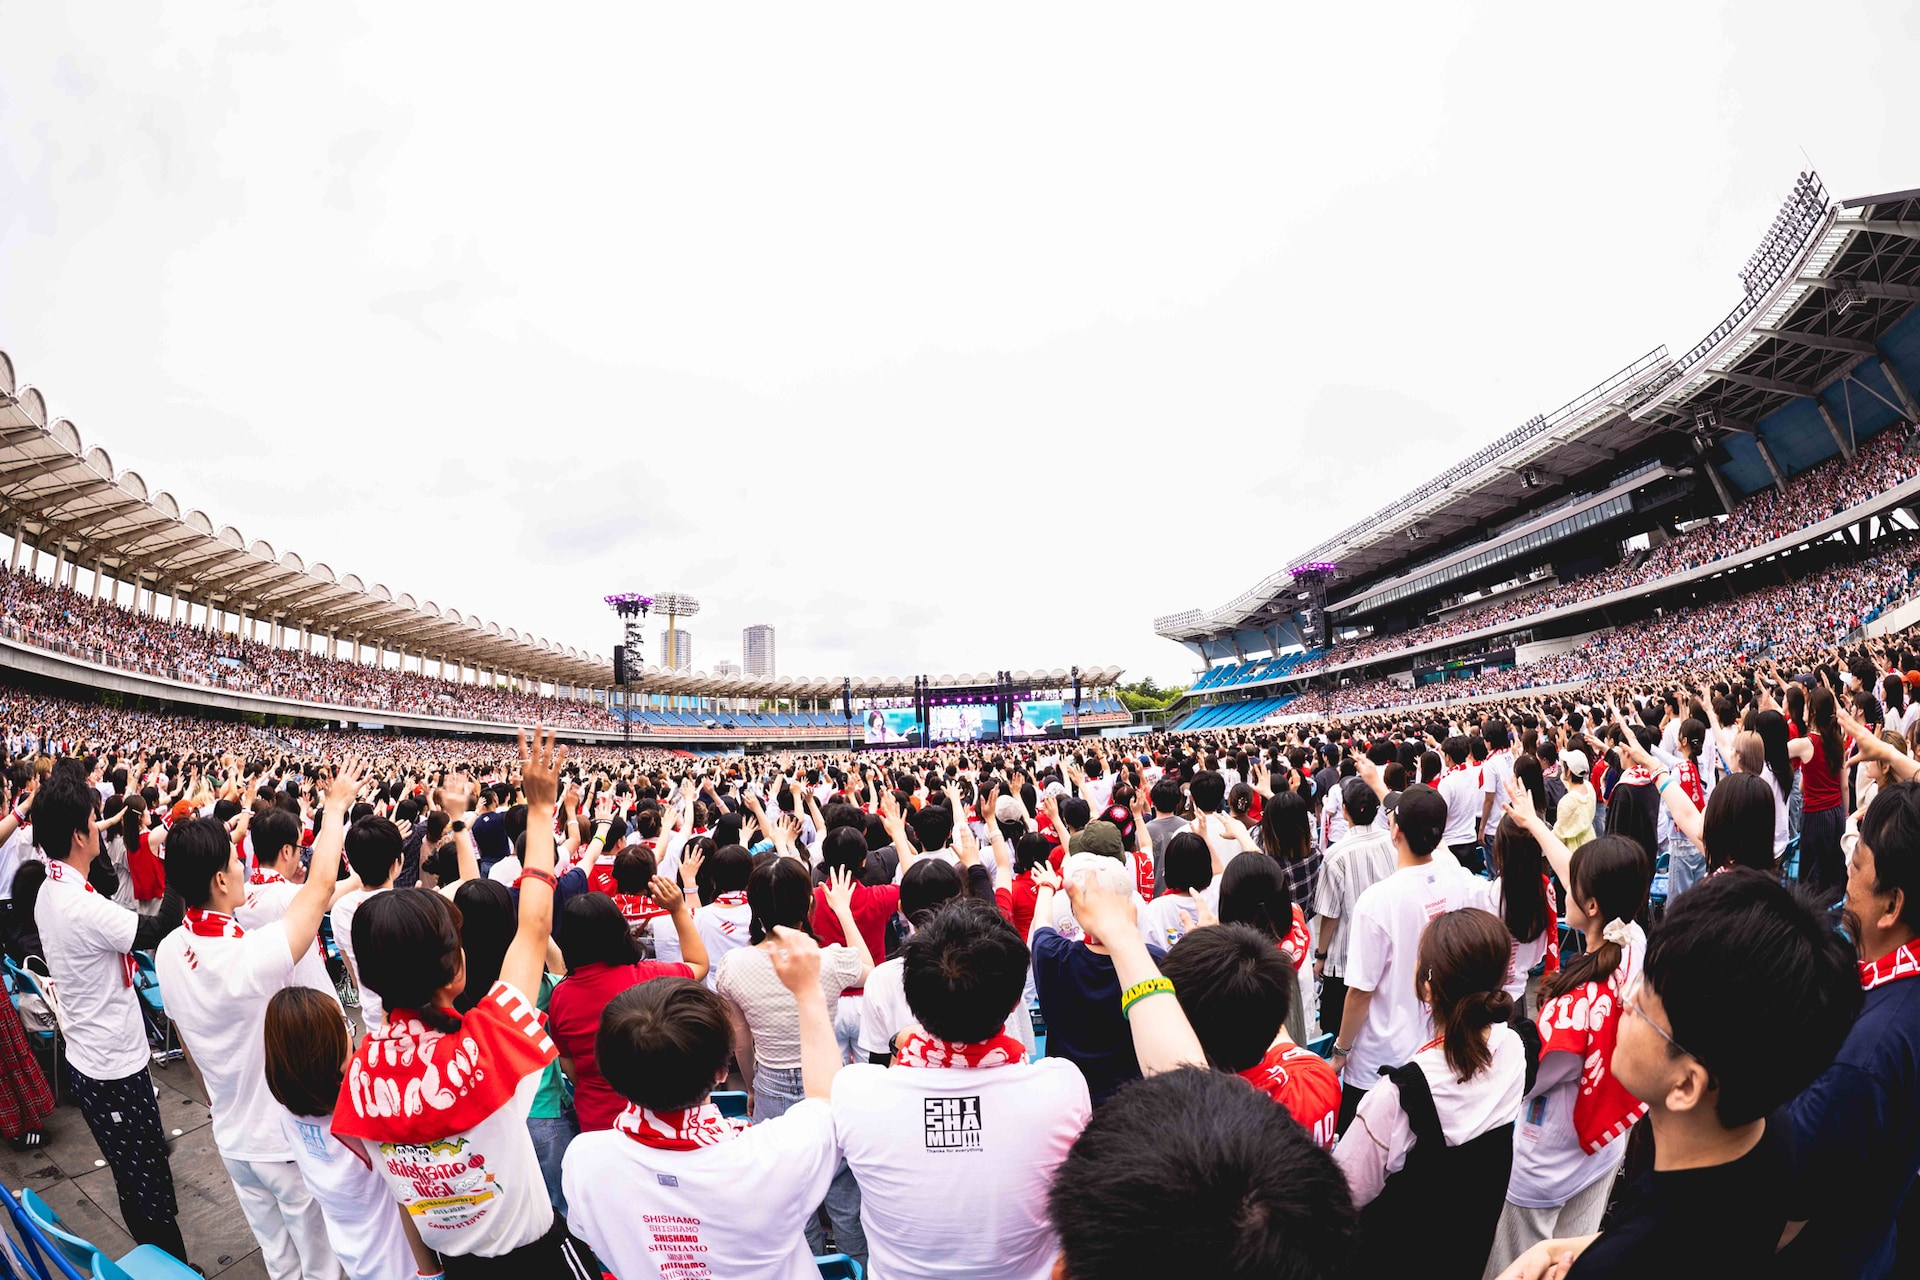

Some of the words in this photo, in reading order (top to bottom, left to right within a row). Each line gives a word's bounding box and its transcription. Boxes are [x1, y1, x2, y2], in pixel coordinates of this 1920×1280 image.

[642, 1214, 701, 1225] SHISHAMO
[648, 1224, 699, 1233] SHISHAMO
[653, 1233, 698, 1243] SHISHAMO
[648, 1244, 708, 1253] SHISHAMO
[659, 1269, 712, 1280] SHISHAMO
